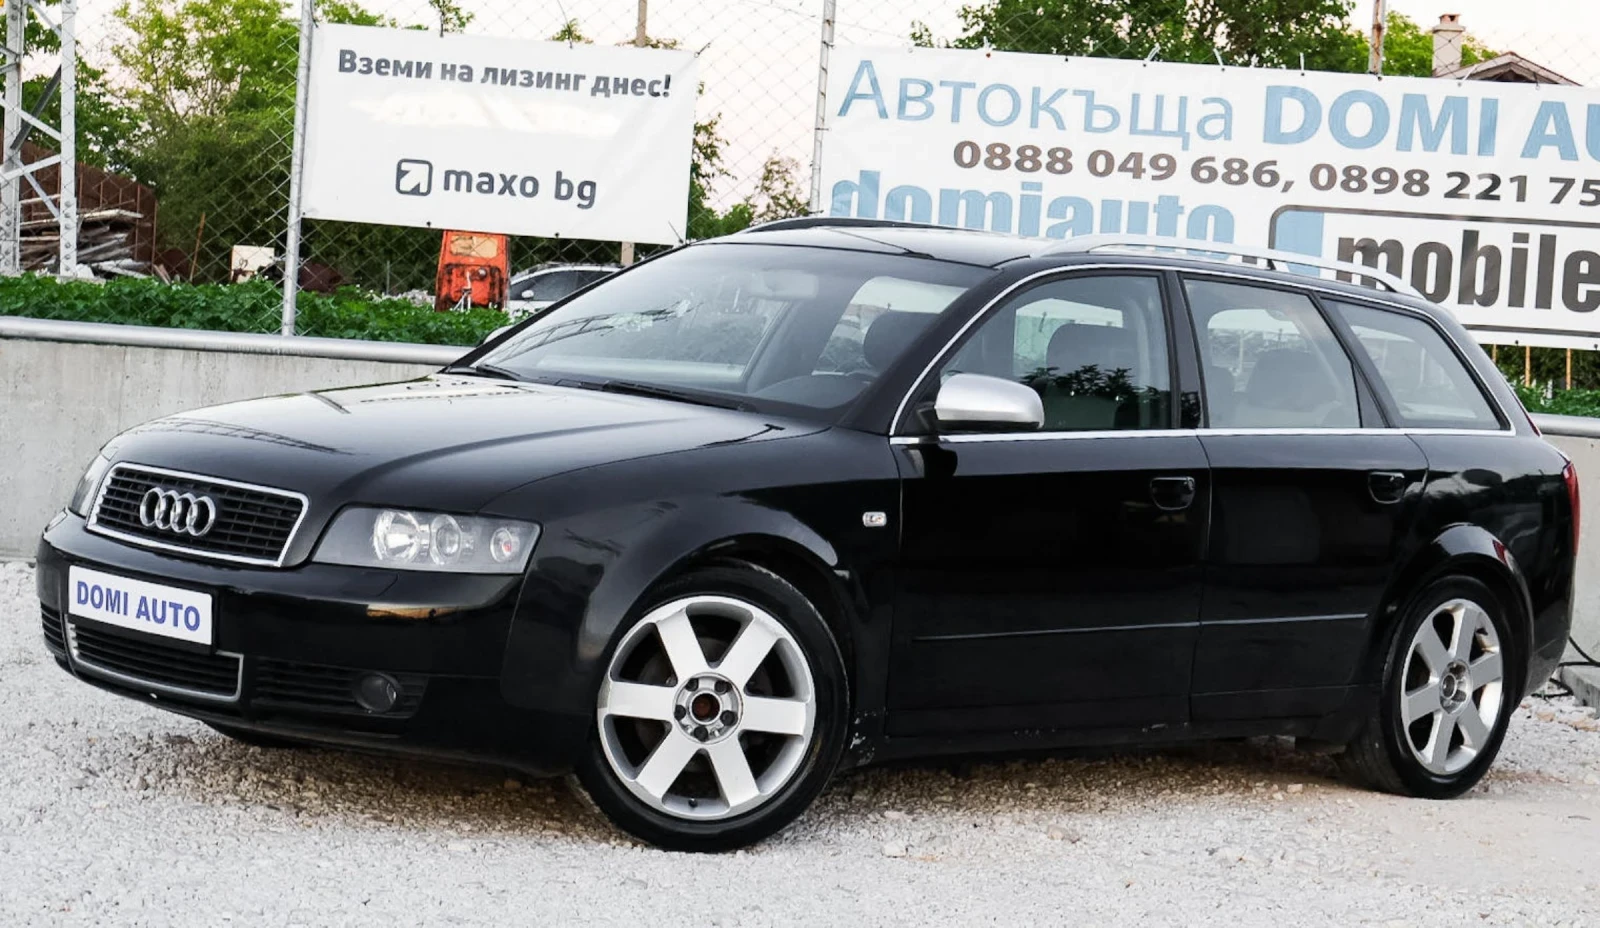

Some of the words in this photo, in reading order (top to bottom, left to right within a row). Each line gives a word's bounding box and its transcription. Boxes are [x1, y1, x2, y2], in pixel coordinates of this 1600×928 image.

[338, 49, 432, 79] Вземи
[440, 62, 474, 84] на
[480, 66, 587, 92] лизинг
[590, 74, 672, 98] днес!
[838, 60, 1232, 151] Автокъща
[1263, 85, 1499, 157] DOMI
[443, 169, 539, 198] maxo
[553, 170, 598, 209] bg
[953, 141, 1073, 174] 0888
[1087, 149, 1178, 181] 049
[1190, 156, 1295, 193] 686,
[1309, 163, 1431, 198] 0898
[1443, 171, 1528, 203] 221
[77, 580, 129, 615] DOMI
[137, 596, 200, 632] AUTO
